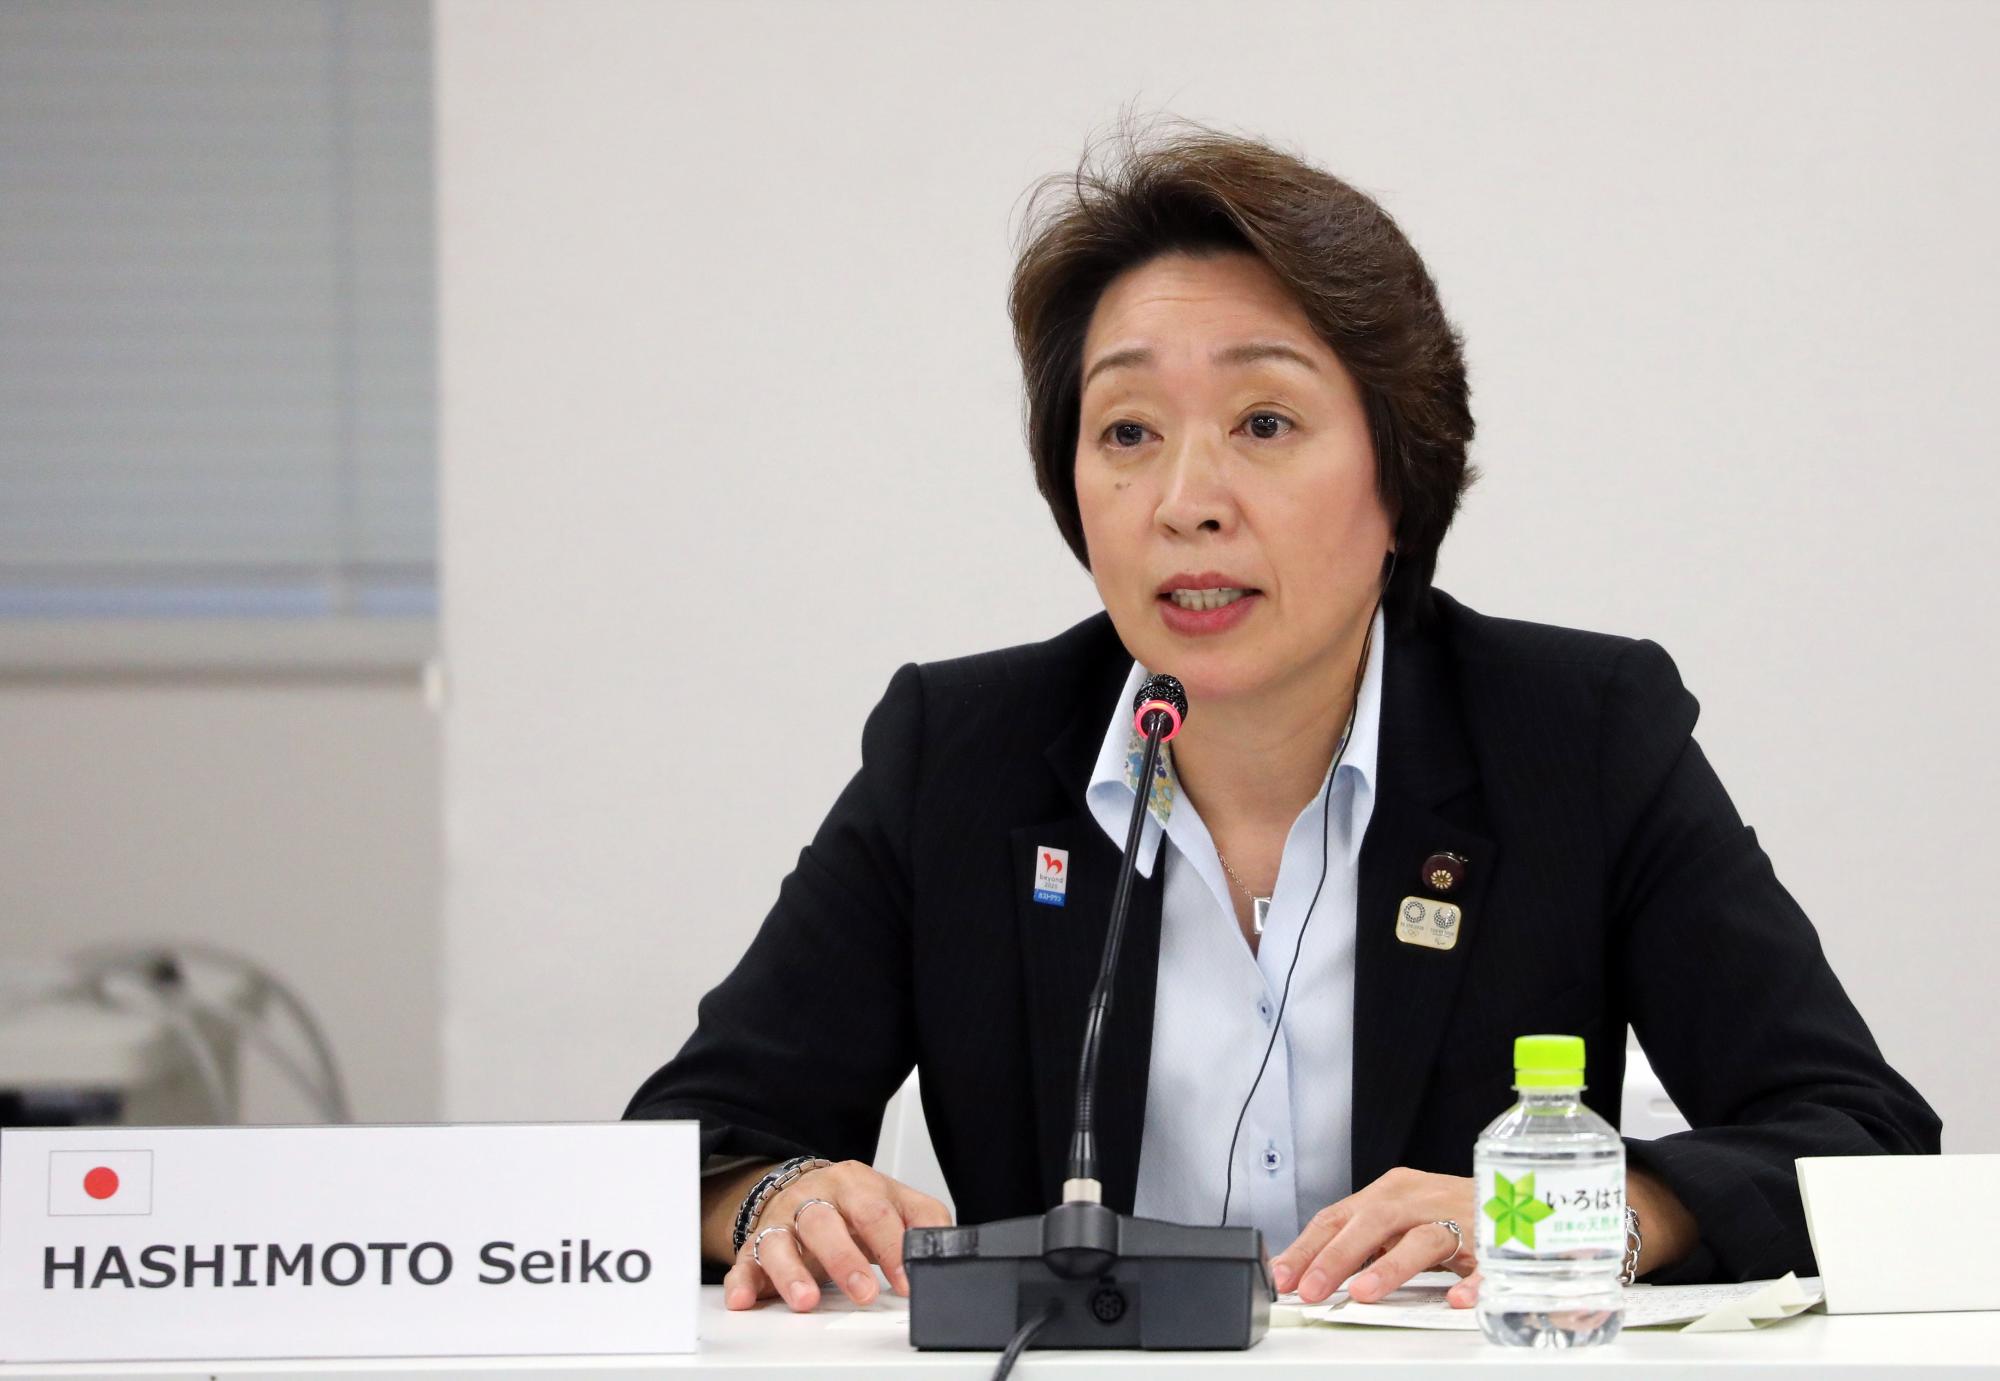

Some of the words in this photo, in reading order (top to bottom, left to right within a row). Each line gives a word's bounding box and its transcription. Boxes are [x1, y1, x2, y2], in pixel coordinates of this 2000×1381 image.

[1039, 873, 1064, 884] beyond
[44, 1241, 453, 1289] HASHIMOTO
[479, 1239, 652, 1285] Seiko
